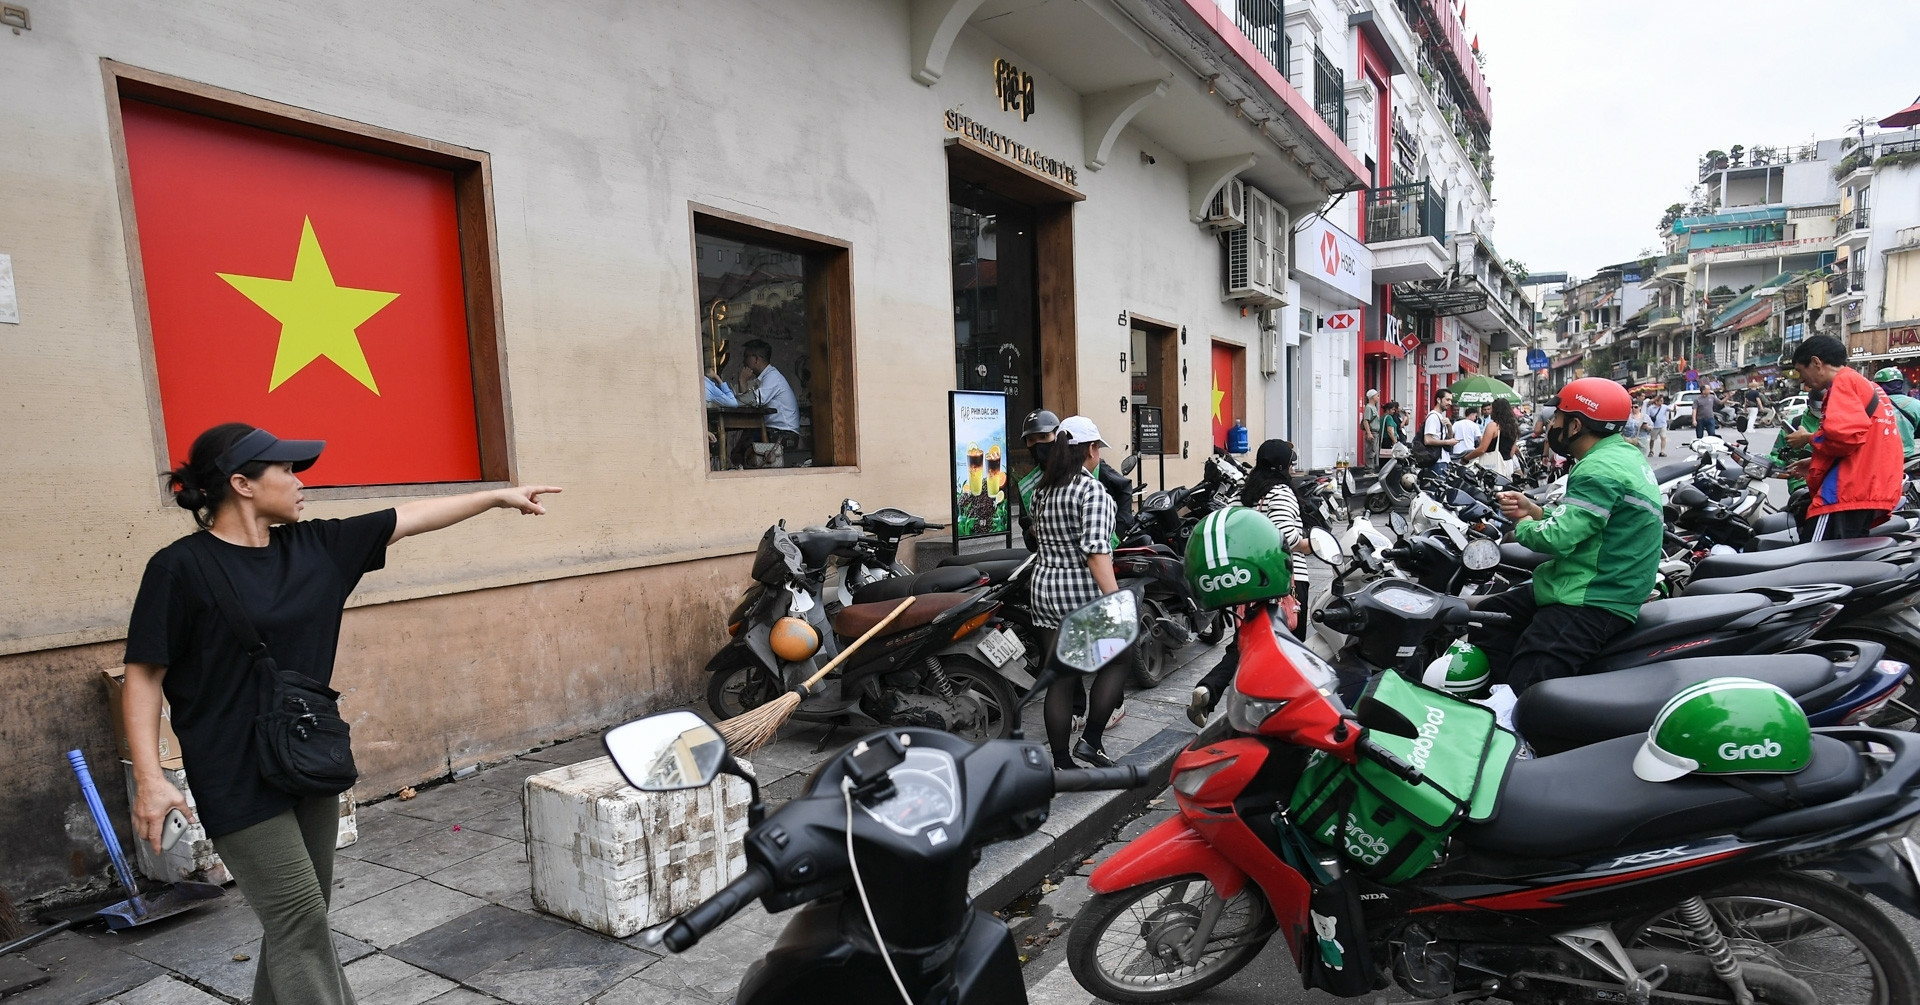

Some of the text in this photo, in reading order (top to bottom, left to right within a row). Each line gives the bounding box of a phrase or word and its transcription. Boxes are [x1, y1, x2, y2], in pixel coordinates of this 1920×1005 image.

[946, 109, 1011, 155] SPECIALTY
[1012, 141, 1032, 166] TEA
[1042, 155, 1078, 186] COFFEE
[1341, 252, 1356, 276] HSBC
[1385, 313, 1403, 347] KFC
[1199, 566, 1251, 592] Grab
[992, 642, 1014, 664] 5102
[1718, 738, 1782, 761] Grab
[1345, 812, 1390, 855] Grab
[1360, 892, 1390, 901] NDA
